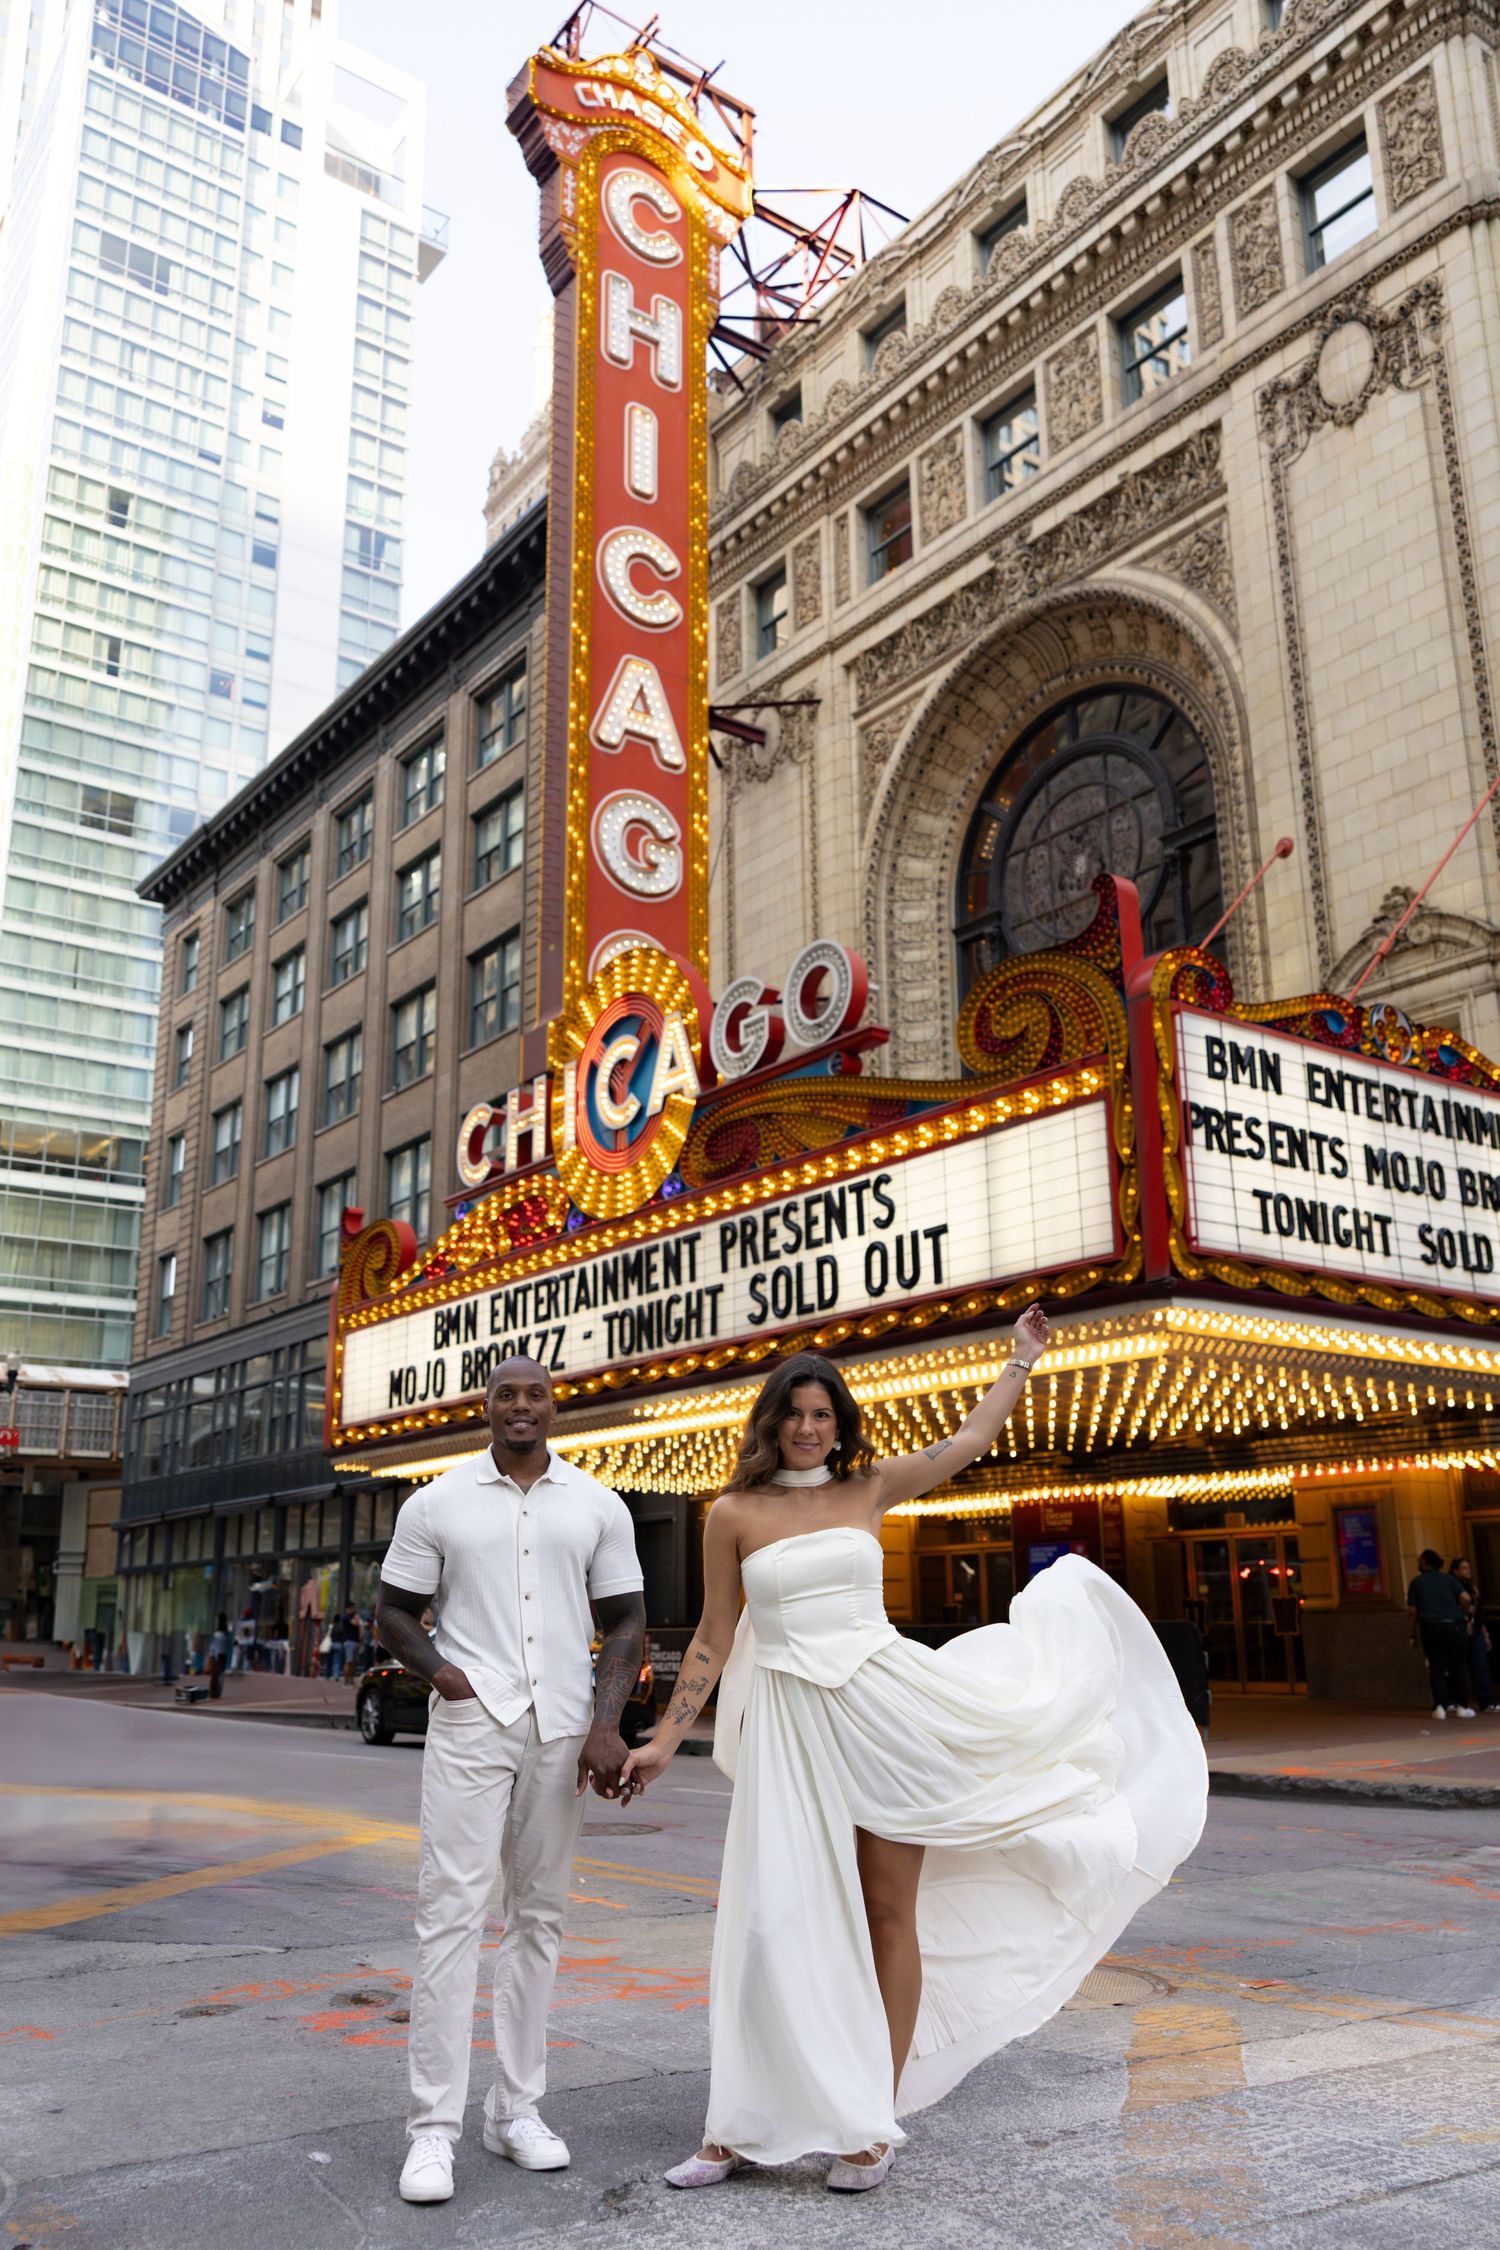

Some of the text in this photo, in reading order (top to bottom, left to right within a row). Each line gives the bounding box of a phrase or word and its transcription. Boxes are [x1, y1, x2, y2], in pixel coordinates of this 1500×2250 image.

[574, 81, 685, 145] CHASE
[456, 938, 855, 1188] CHICAGO
[1205, 1034, 1500, 1150] BMN ENTERTAINM
[1183, 1100, 1348, 1179] PRESENTS
[1364, 1144, 1446, 1202] MOJO
[434, 1173, 896, 1350] BMN ENTERTAINMENT PRESENTS
[1252, 1189, 1494, 1274] TONIGHT SOLD
[389, 1358, 446, 1408] MOJO
[603, 1283, 724, 1359] TONIGHT
[748, 1255, 839, 1325] SOLD
[864, 1223, 948, 1297] OUT
